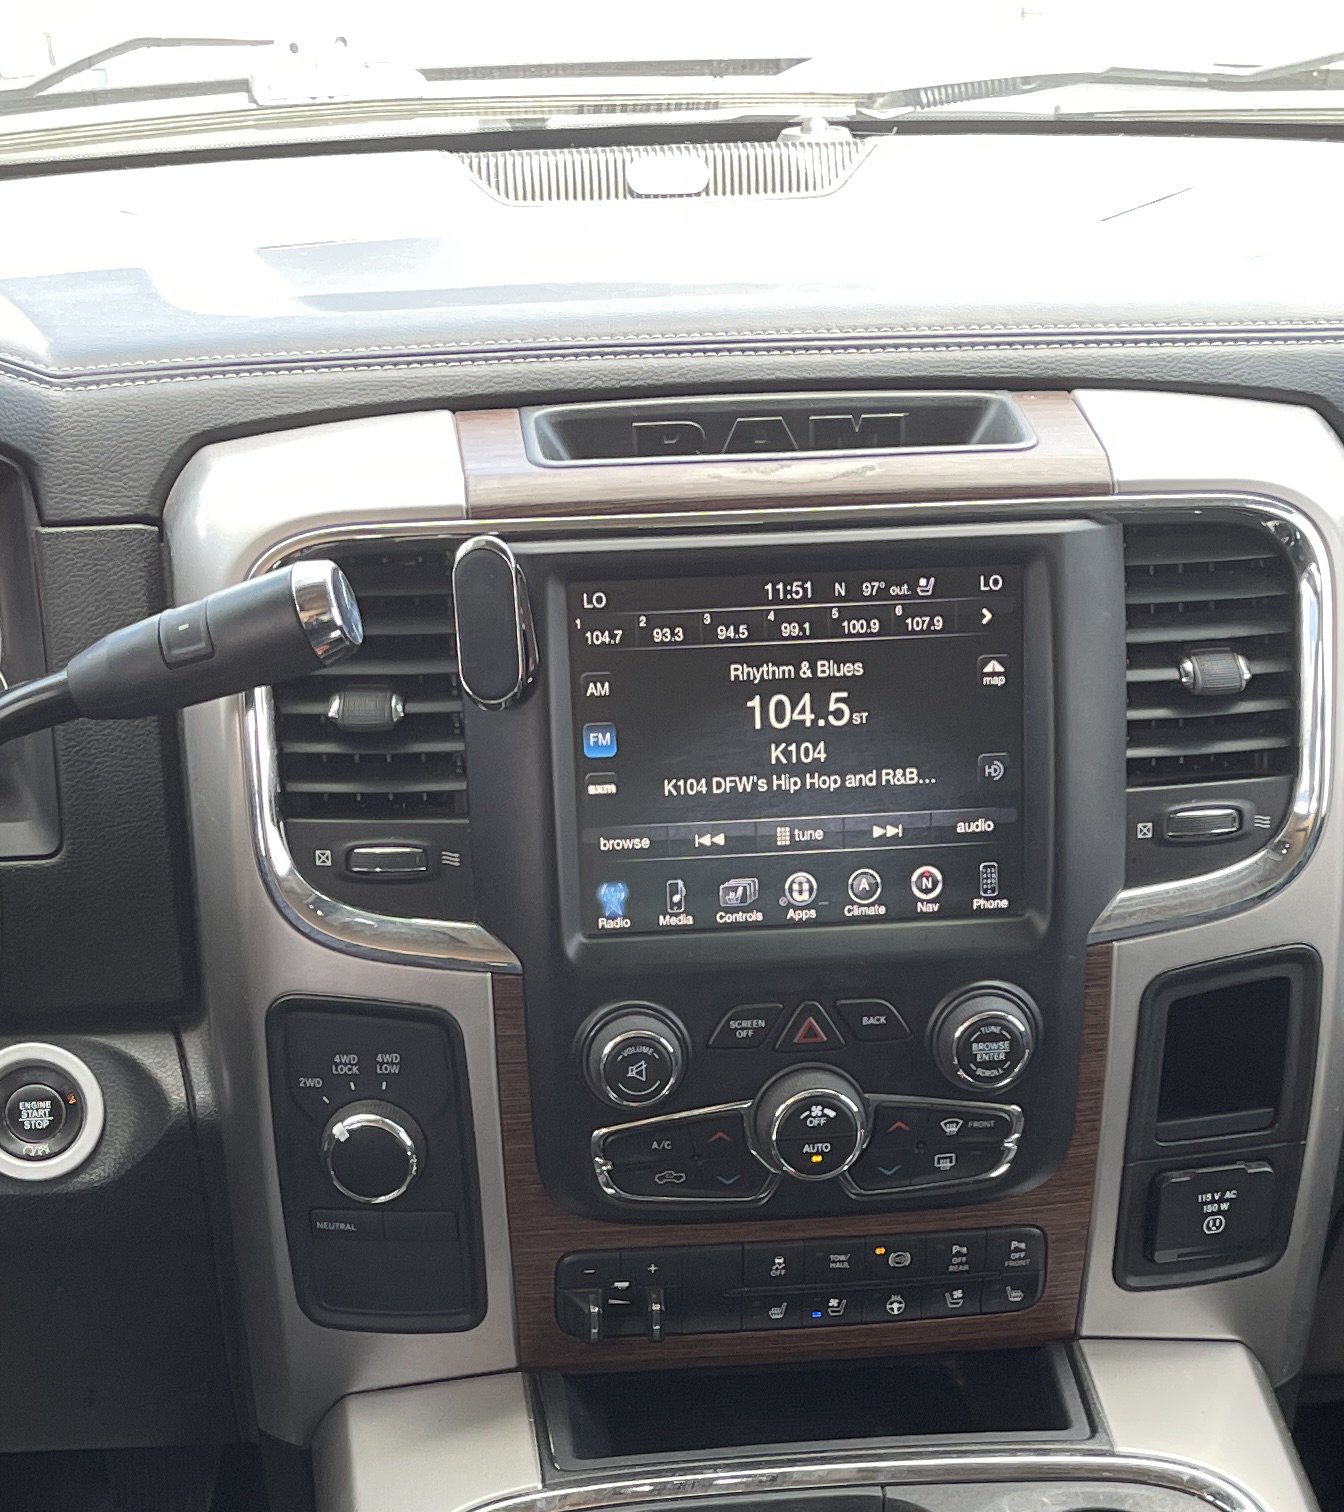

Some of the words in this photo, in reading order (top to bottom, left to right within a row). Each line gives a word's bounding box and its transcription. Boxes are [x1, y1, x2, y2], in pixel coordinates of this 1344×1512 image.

[862, 581, 886, 596] 97°
[980, 575, 1003, 591] LO
[765, 581, 813, 600] 11:51
[834, 582, 846, 596] N
[583, 591, 607, 609] LO
[767, 610, 775, 621] 4
[831, 607, 839, 618] 5
[895, 605, 903, 616] 6
[575, 618, 581, 630] 1
[639, 616, 647, 627] 2
[703, 613, 711, 624] 3
[906, 616, 943, 631] 107.9
[717, 624, 748, 640] 94.5
[781, 622, 810, 637] 99.1
[842, 619, 880, 634] 100.9
[585, 630, 623, 645] 104.7
[653, 627, 684, 642] 93.3
[730, 662, 795, 684] Rhythm
[799, 661, 813, 678] &
[816, 660, 864, 677] Blues
[586, 682, 610, 696] AM
[746, 693, 849, 730] 104.5
[852, 712, 869, 725] ST
[589, 733, 612, 746] FM
[770, 741, 827, 764] K104
[664, 778, 707, 796] K104
[712, 775, 768, 794] DFW's
[773, 773, 801, 793] Hip
[806, 772, 841, 792] Hop
[845, 769, 877, 787] and
[881, 767, 937, 786] R&B...
[956, 818, 995, 833] audio
[794, 828, 825, 842] tune
[600, 837, 650, 851] browse
[917, 901, 940, 913] Nav
[973, 898, 1009, 910] Phone
[787, 908, 817, 921] Apps
[844, 905, 886, 917] Climate
[659, 914, 694, 926] Media
[716, 911, 763, 923] Controls
[598, 917, 631, 929] Radio
[729, 1019, 765, 1029] SCREEN
[862, 1015, 887, 1026] BACK
[736, 1029, 754, 1039] OFF
[980, 1025, 1002, 1035] TUNE
[621, 1045, 654, 1057] VOLUME
[972, 1041, 1010, 1051] BROWSE
[334, 1054, 358, 1064] 4WD
[376, 1053, 400, 1064] 4WD
[976, 1052, 1006, 1062] ENTER
[332, 1064, 360, 1075] LOCK
[376, 1064, 399, 1074] LOW
[975, 1067, 1004, 1078] SCROLL
[299, 1077, 322, 1088] 2WD
[19, 1101, 51, 1110] ENGINE
[21, 1109, 50, 1119] START
[23, 1120, 49, 1130] STOP
[806, 1117, 827, 1127] OFF
[968, 1119, 995, 1129] FRONT
[652, 1140, 672, 1150] A/C
[803, 1143, 831, 1153] AUTO
[1213, 1191, 1221, 1201] V
[1224, 1189, 1237, 1200] AC
[1203, 1203, 1218, 1213] 150
[1219, 1202, 1230, 1212] W
[316, 1221, 357, 1231] NEUTRAL
[952, 1256, 967, 1264] OFF
[1010, 1251, 1026, 1259] OFF
[829, 1261, 850, 1269] HAUL
[949, 1264, 969, 1272] REAR
[1005, 1259, 1031, 1268] FRONT
[770, 1269, 785, 1277] OFF
